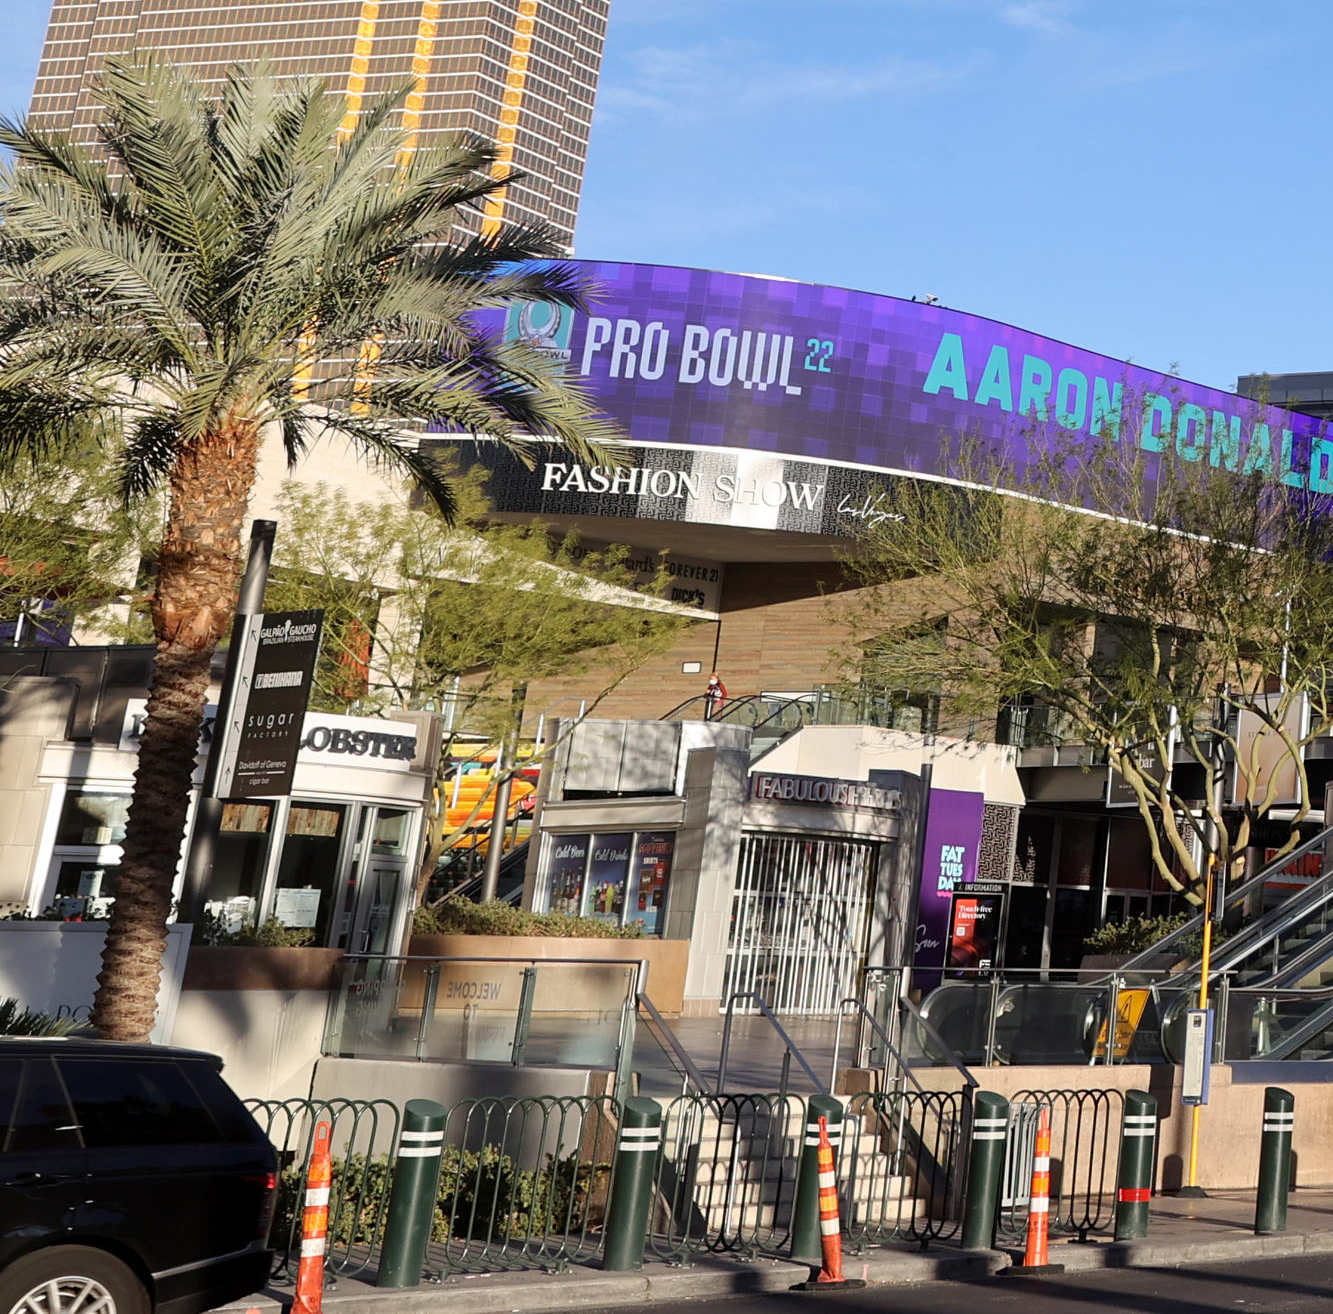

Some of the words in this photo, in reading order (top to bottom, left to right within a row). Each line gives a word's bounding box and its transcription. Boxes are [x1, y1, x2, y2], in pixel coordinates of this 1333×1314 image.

[581, 317, 670, 380] PRO
[678, 324, 802, 396] BOWL
[804, 338, 834, 374] 22
[922, 332, 1124, 442] AARON
[541, 462, 700, 502] FASHION
[713, 475, 824, 511] SHOW
[289, 623, 317, 636] GAUCHO
[262, 671, 303, 687] BENIHANA
[248, 712, 294, 729] sugar
[248, 731, 289, 739] FACTORY
[238, 760, 260, 770] Davidoff
[266, 759, 287, 769] Geneva
[758, 776, 849, 807] FABULOUS
[555, 846, 571, 859] Cold
[941, 845, 965, 863] FAT
[940, 863, 963, 876] TUES
[964, 883, 1002, 892] INFORMATION
